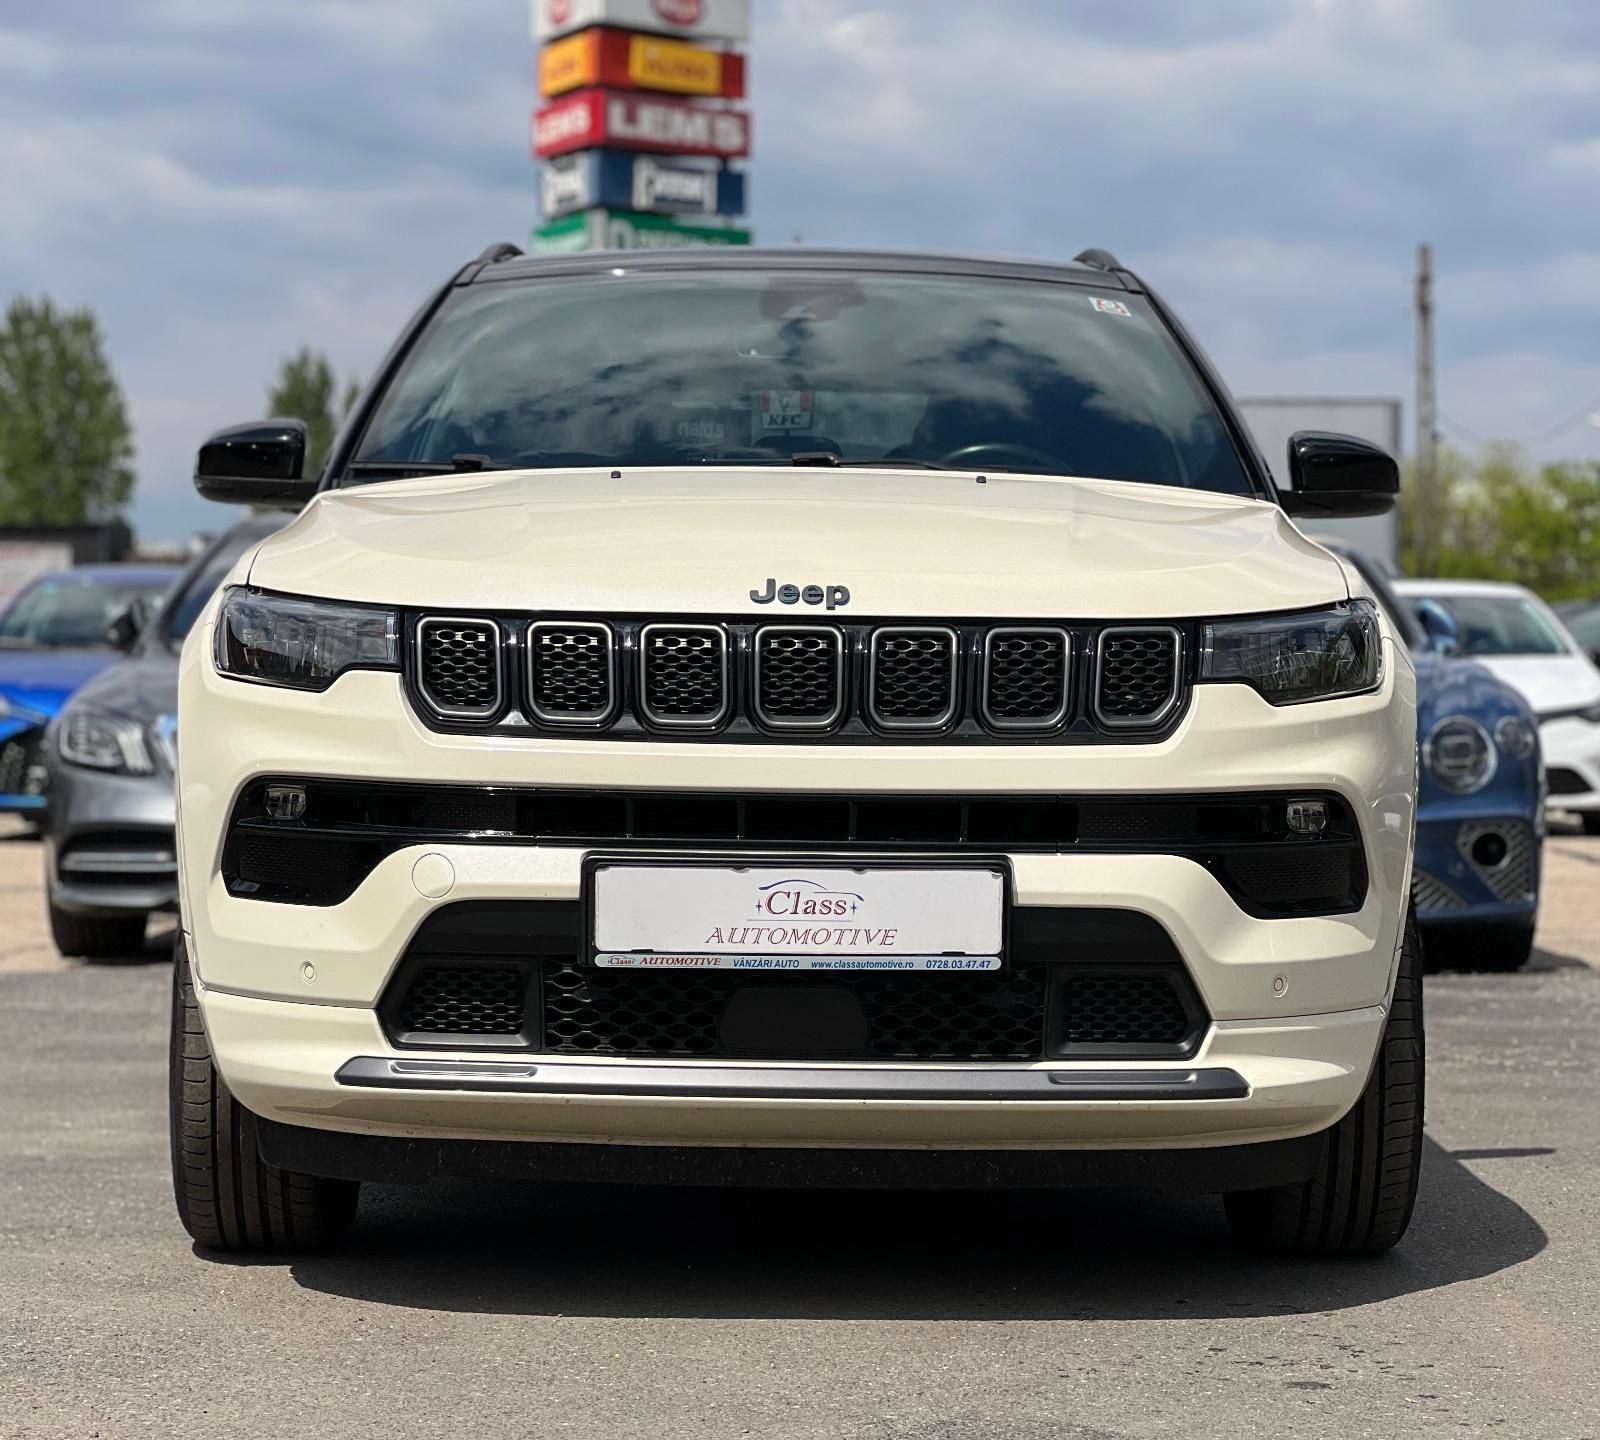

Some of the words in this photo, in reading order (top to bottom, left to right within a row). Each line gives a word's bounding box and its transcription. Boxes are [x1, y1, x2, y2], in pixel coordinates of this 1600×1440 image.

[768, 414, 801, 426] KFC
[749, 578, 851, 611] Jeep
[765, 890, 848, 916] Class
[704, 926, 898, 947] AUTOMOTIVE
[610, 957, 632, 965] Class
[640, 957, 721, 967] AUTOMOTIVE
[774, 960, 800, 969] AUTO
[811, 959, 914, 970] www.classautomotive.ro
[926, 960, 991, 970] 0728.03.47.47
